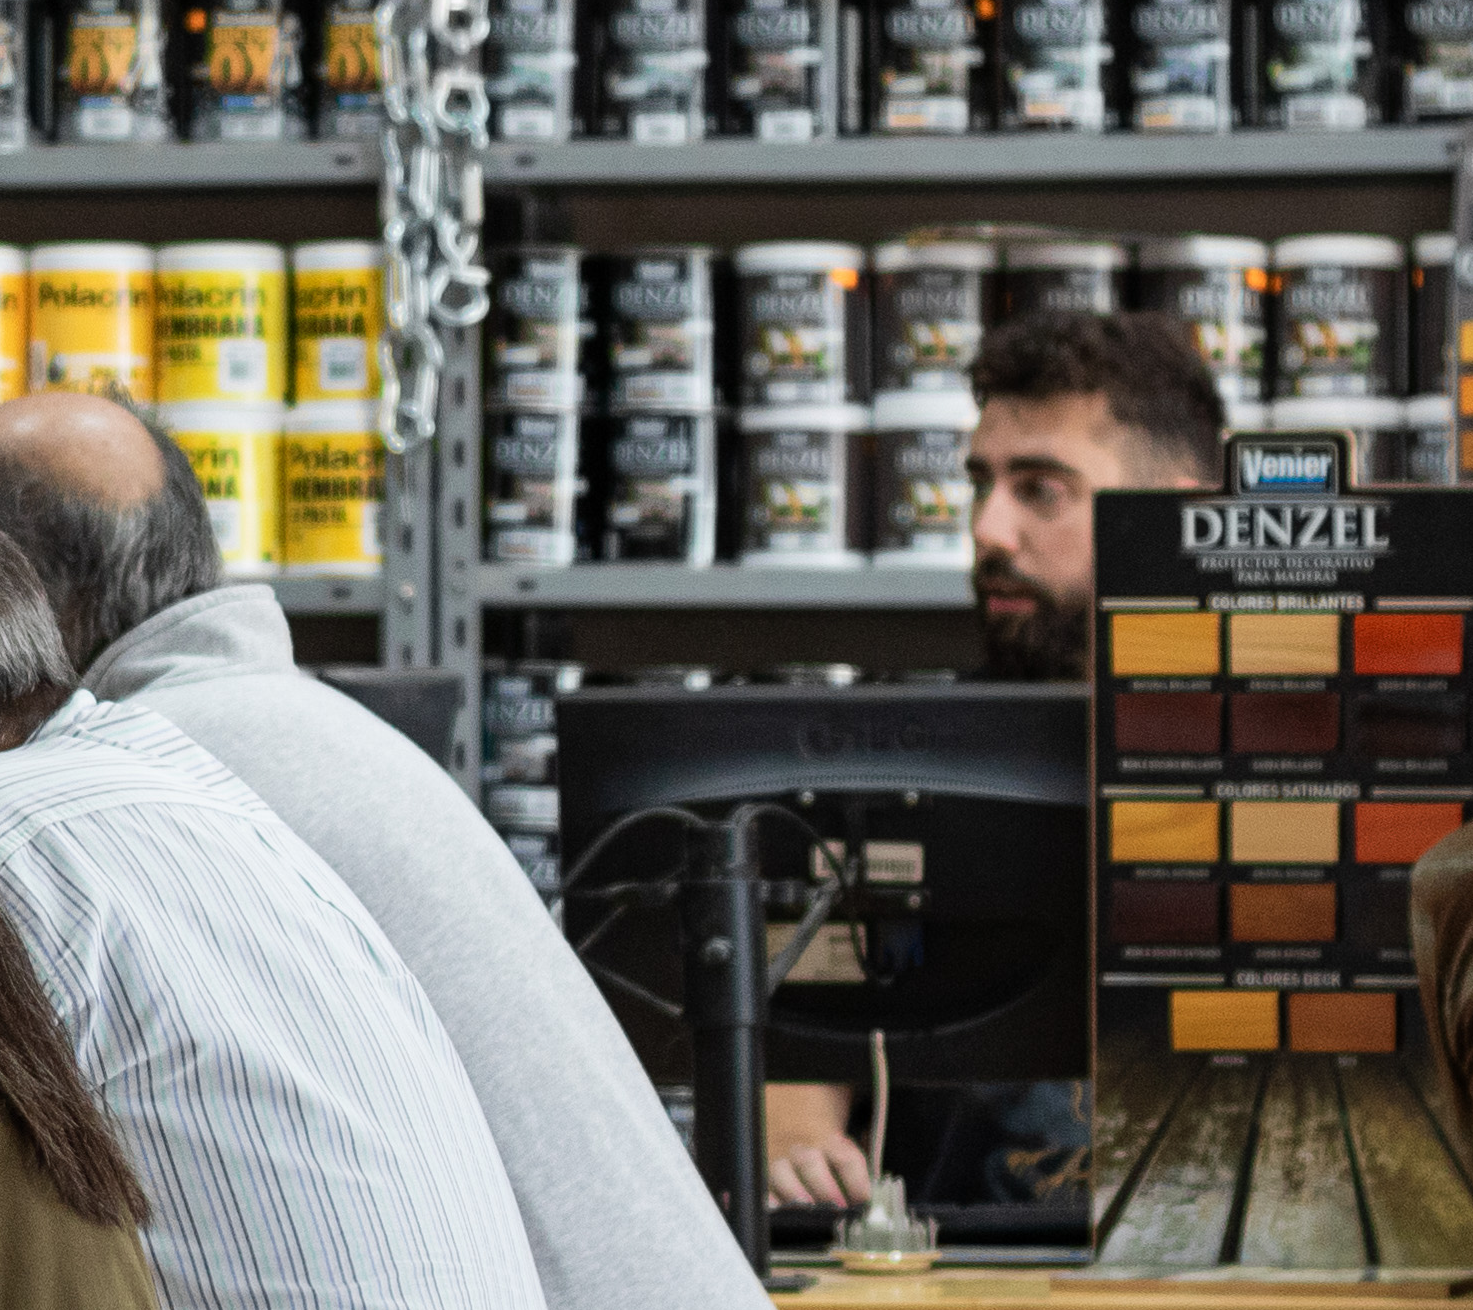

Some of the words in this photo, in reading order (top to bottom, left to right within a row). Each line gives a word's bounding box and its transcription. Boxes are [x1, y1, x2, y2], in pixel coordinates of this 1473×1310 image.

[38, 283, 148, 308] Polacrin
[1242, 449, 1332, 484] Venier
[1182, 506, 1390, 550] DENZEL
[1201, 557, 1282, 569] PROTECTOR
[1286, 557, 1375, 569] DECORATIVO
[1237, 571, 1271, 583] PARA
[1275, 571, 1337, 583] MADERAS
[1211, 596, 1274, 611] COLORES
[1277, 596, 1366, 611] BRILLANTES
[1216, 785, 1278, 798] COLORES
[1237, 972, 1300, 987] COLORES
[1303, 972, 1341, 987] DECK
